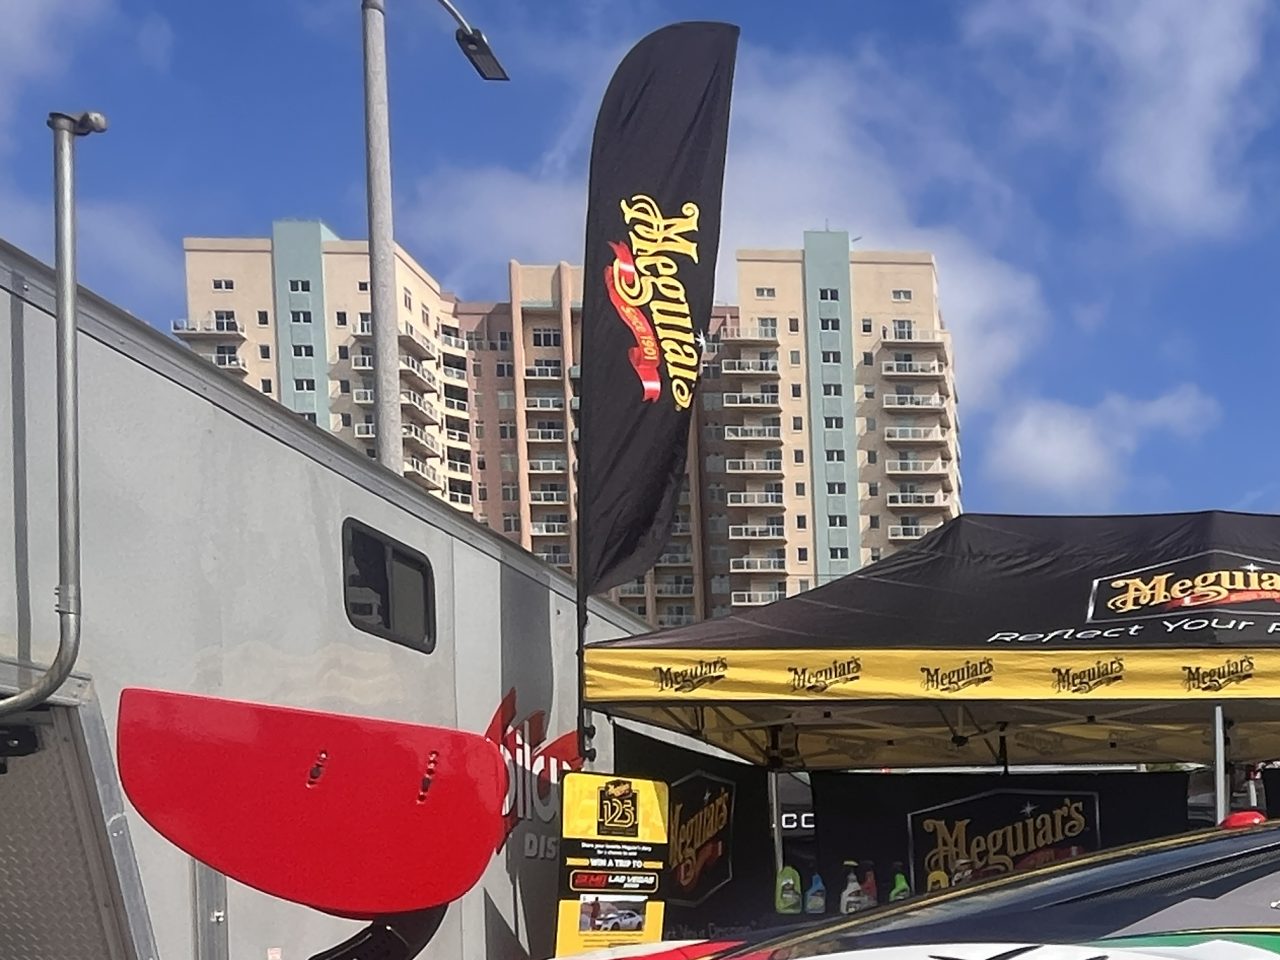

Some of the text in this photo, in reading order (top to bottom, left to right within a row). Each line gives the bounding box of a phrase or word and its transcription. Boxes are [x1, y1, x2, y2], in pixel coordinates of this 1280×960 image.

[620, 194, 700, 411] Meguiar's
[987, 624, 1144, 643] Reflect
[1162, 618, 1255, 633] Your
[653, 655, 729, 692] Meguiar's
[788, 656, 863, 692] Meguiar's
[920, 656, 995, 693] Meguiar's
[1052, 656, 1126, 693] Meguiar's
[1182, 655, 1255, 692] Meguiar's
[922, 798, 1086, 872] Meguiar's
[632, 860, 643, 868] TO
